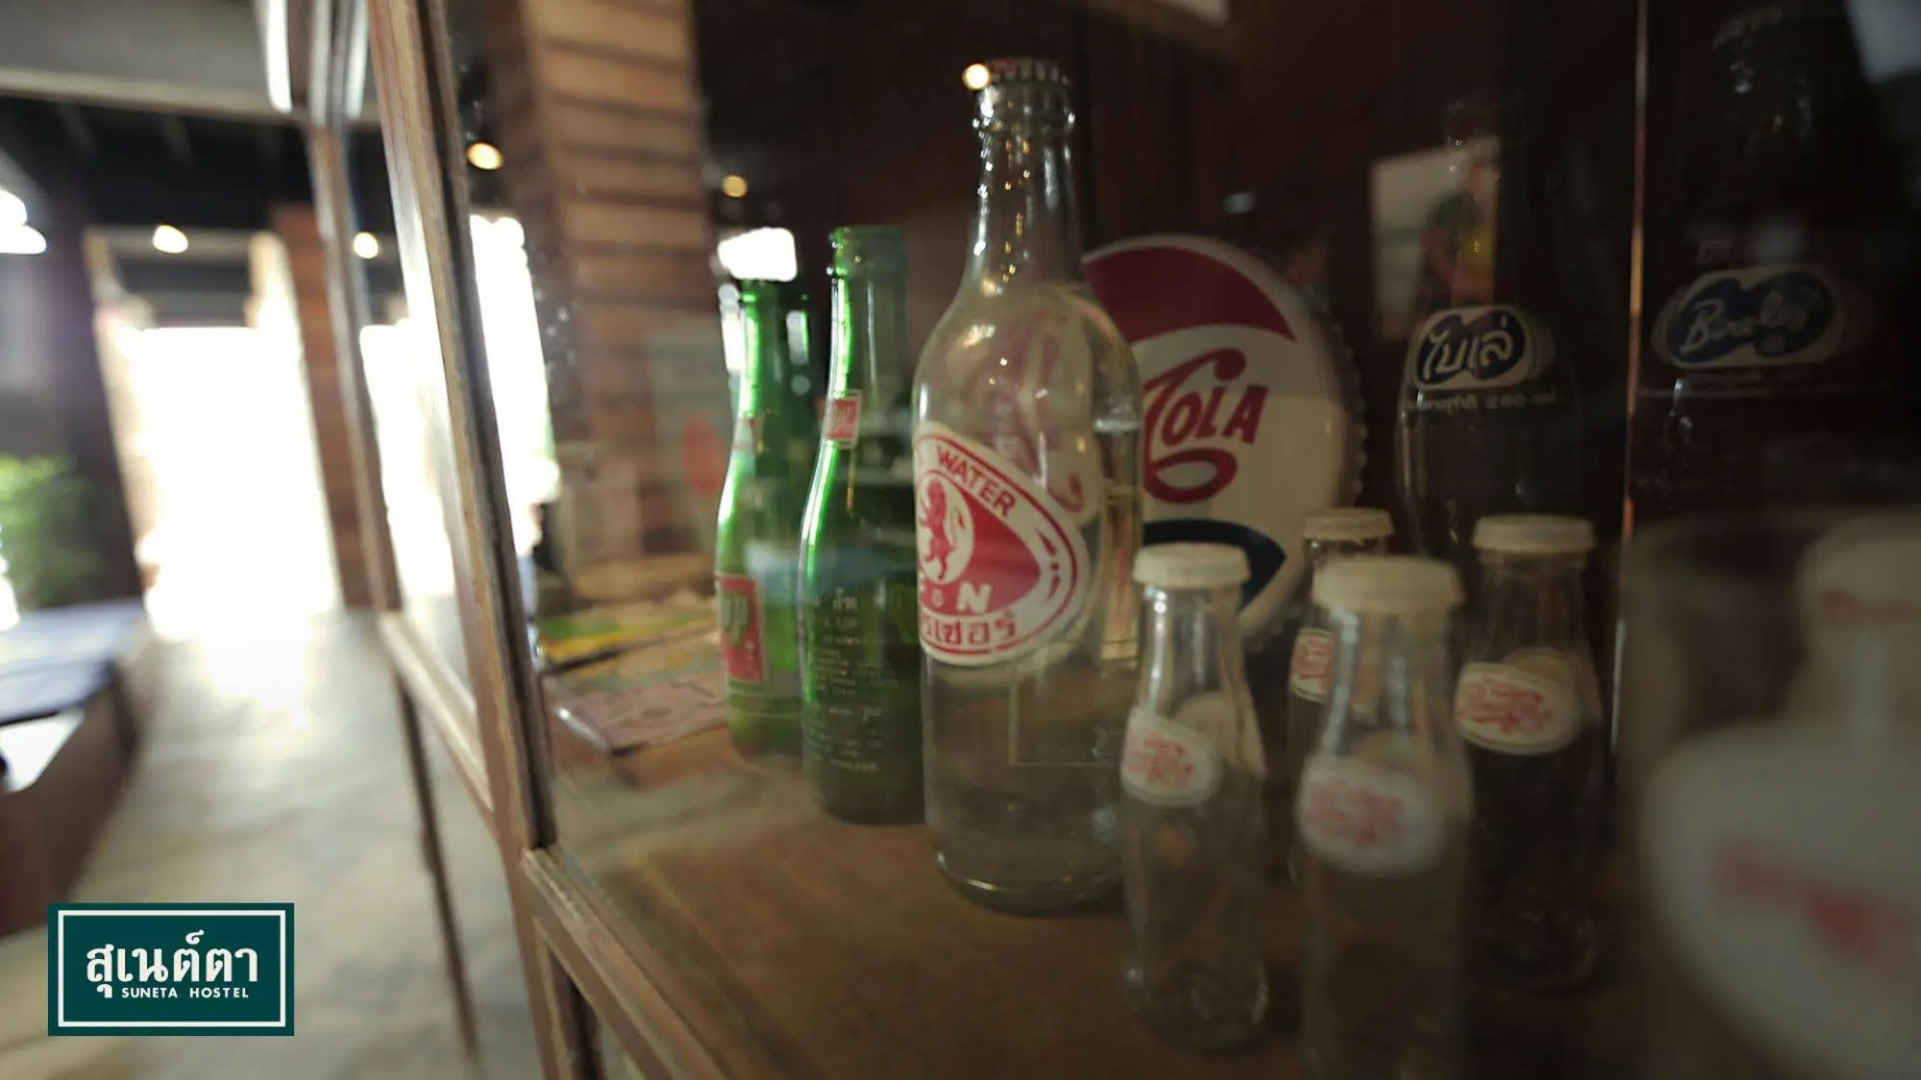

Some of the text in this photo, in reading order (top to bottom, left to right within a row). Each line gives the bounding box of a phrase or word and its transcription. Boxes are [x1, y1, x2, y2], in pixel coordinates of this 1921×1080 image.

[1413, 314, 1514, 381] ไบเล่
[936, 446, 1017, 517] WATER
[956, 582, 986, 613] N
